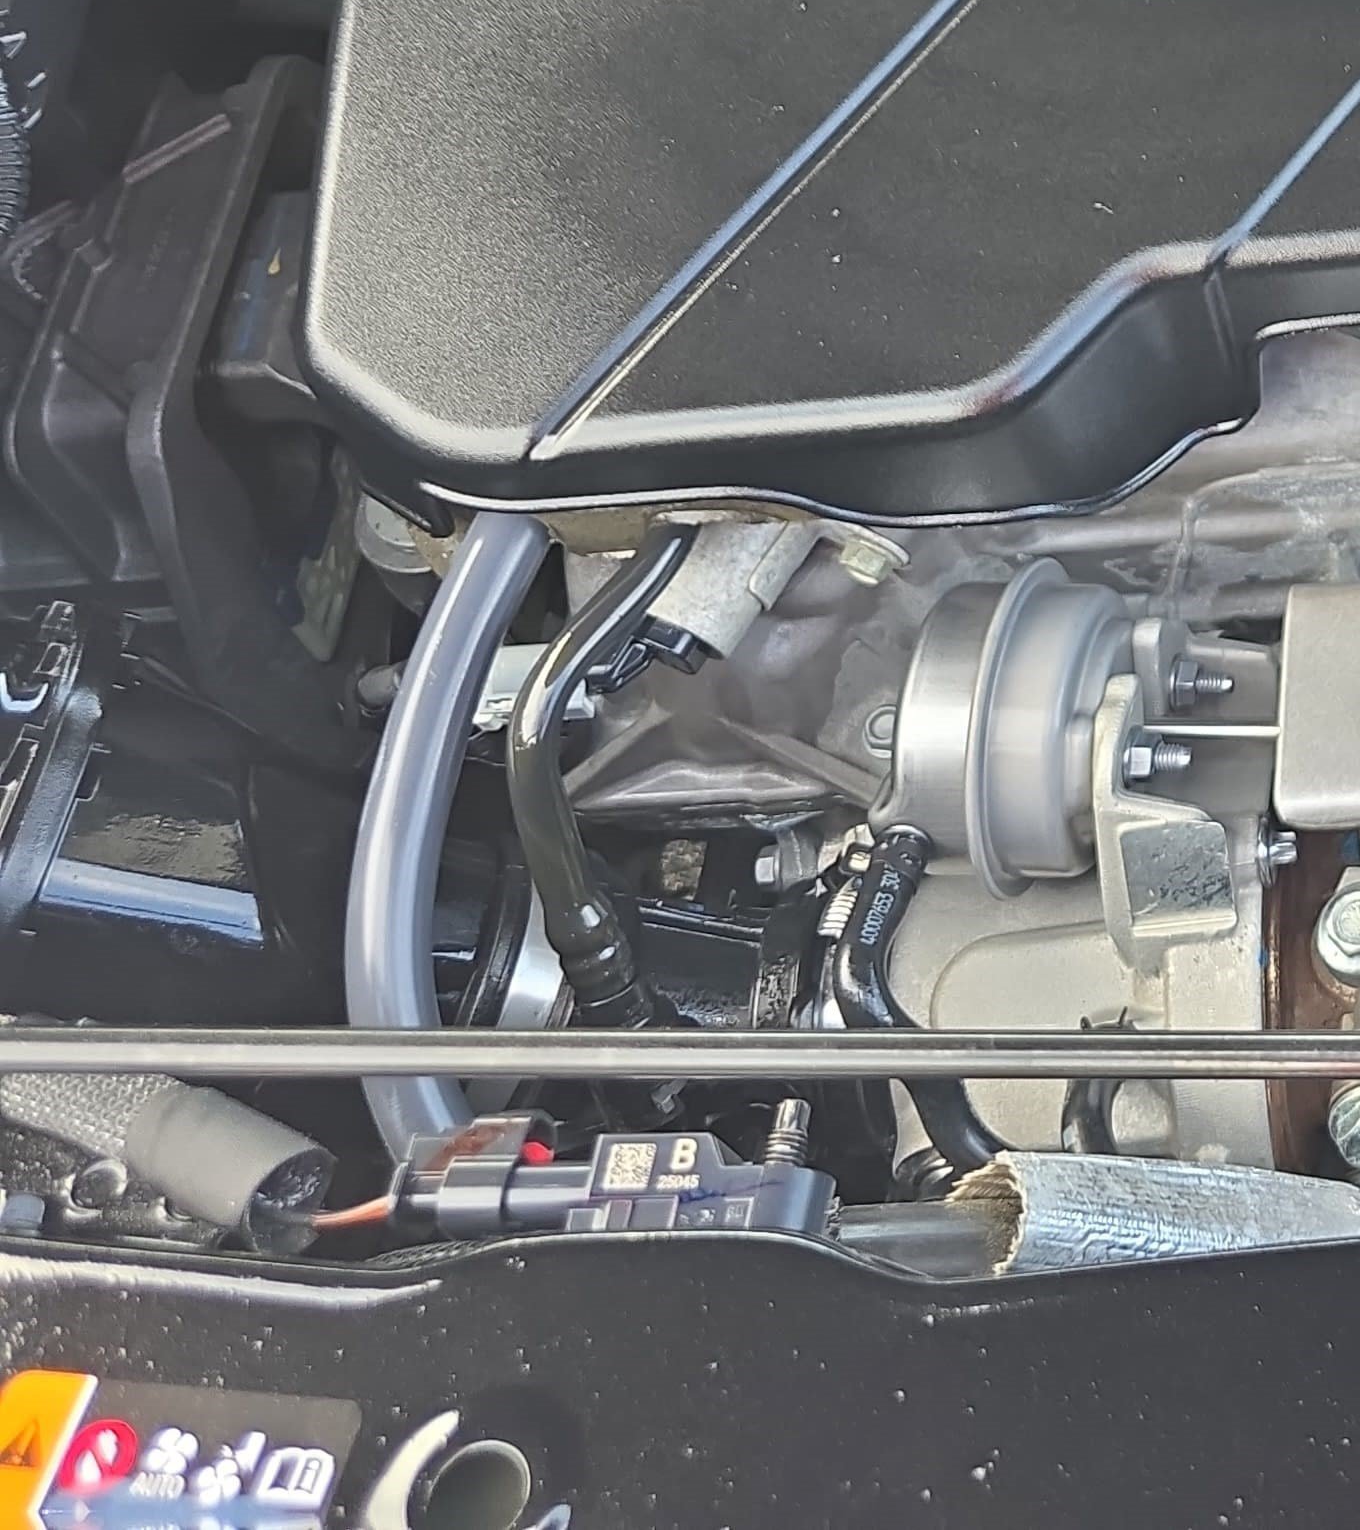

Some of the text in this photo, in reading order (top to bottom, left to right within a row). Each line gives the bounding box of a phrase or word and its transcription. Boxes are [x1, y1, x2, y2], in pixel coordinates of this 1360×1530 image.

[859, 890, 895, 945] 40007653
[670, 1137, 698, 1173] B
[655, 1173, 701, 1191] 25045
[129, 1471, 186, 1501] AUTO
